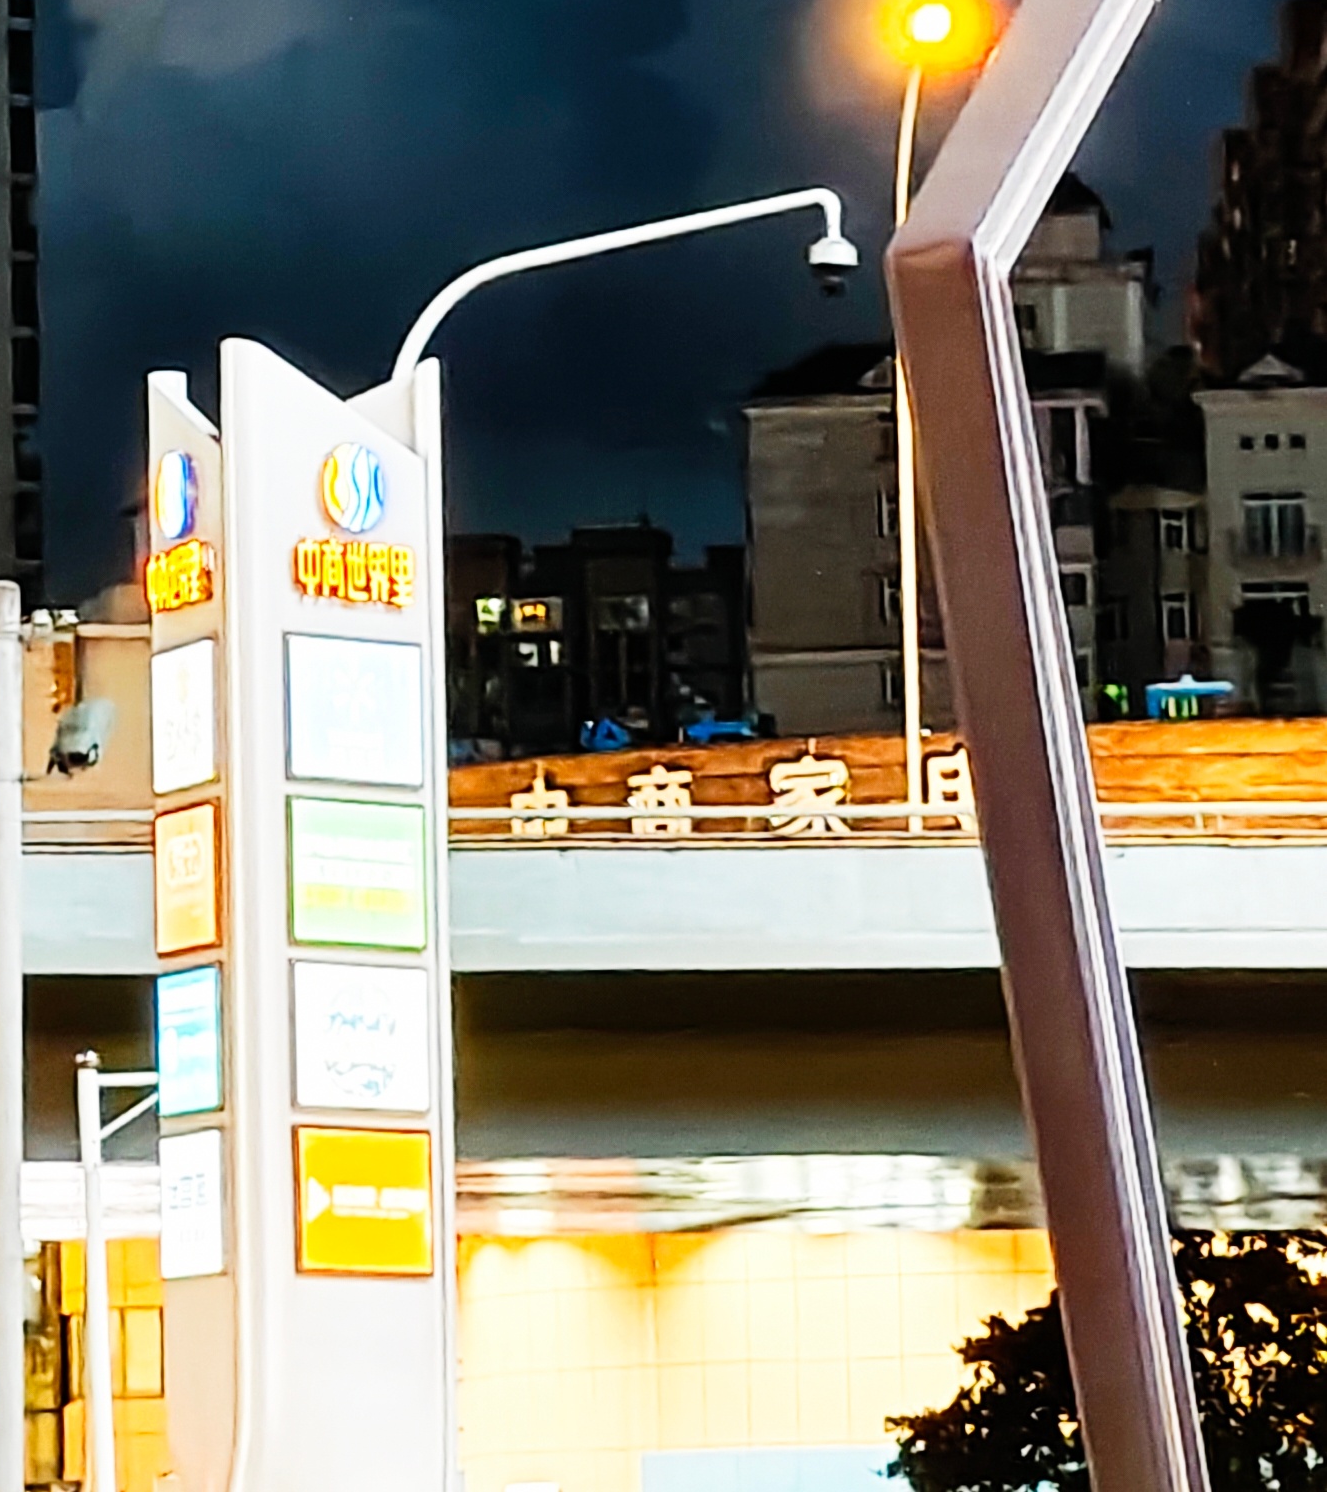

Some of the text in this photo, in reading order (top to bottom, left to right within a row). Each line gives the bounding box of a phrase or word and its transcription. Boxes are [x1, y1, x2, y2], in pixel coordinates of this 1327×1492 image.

[293, 538, 415, 608] 中商世界里
